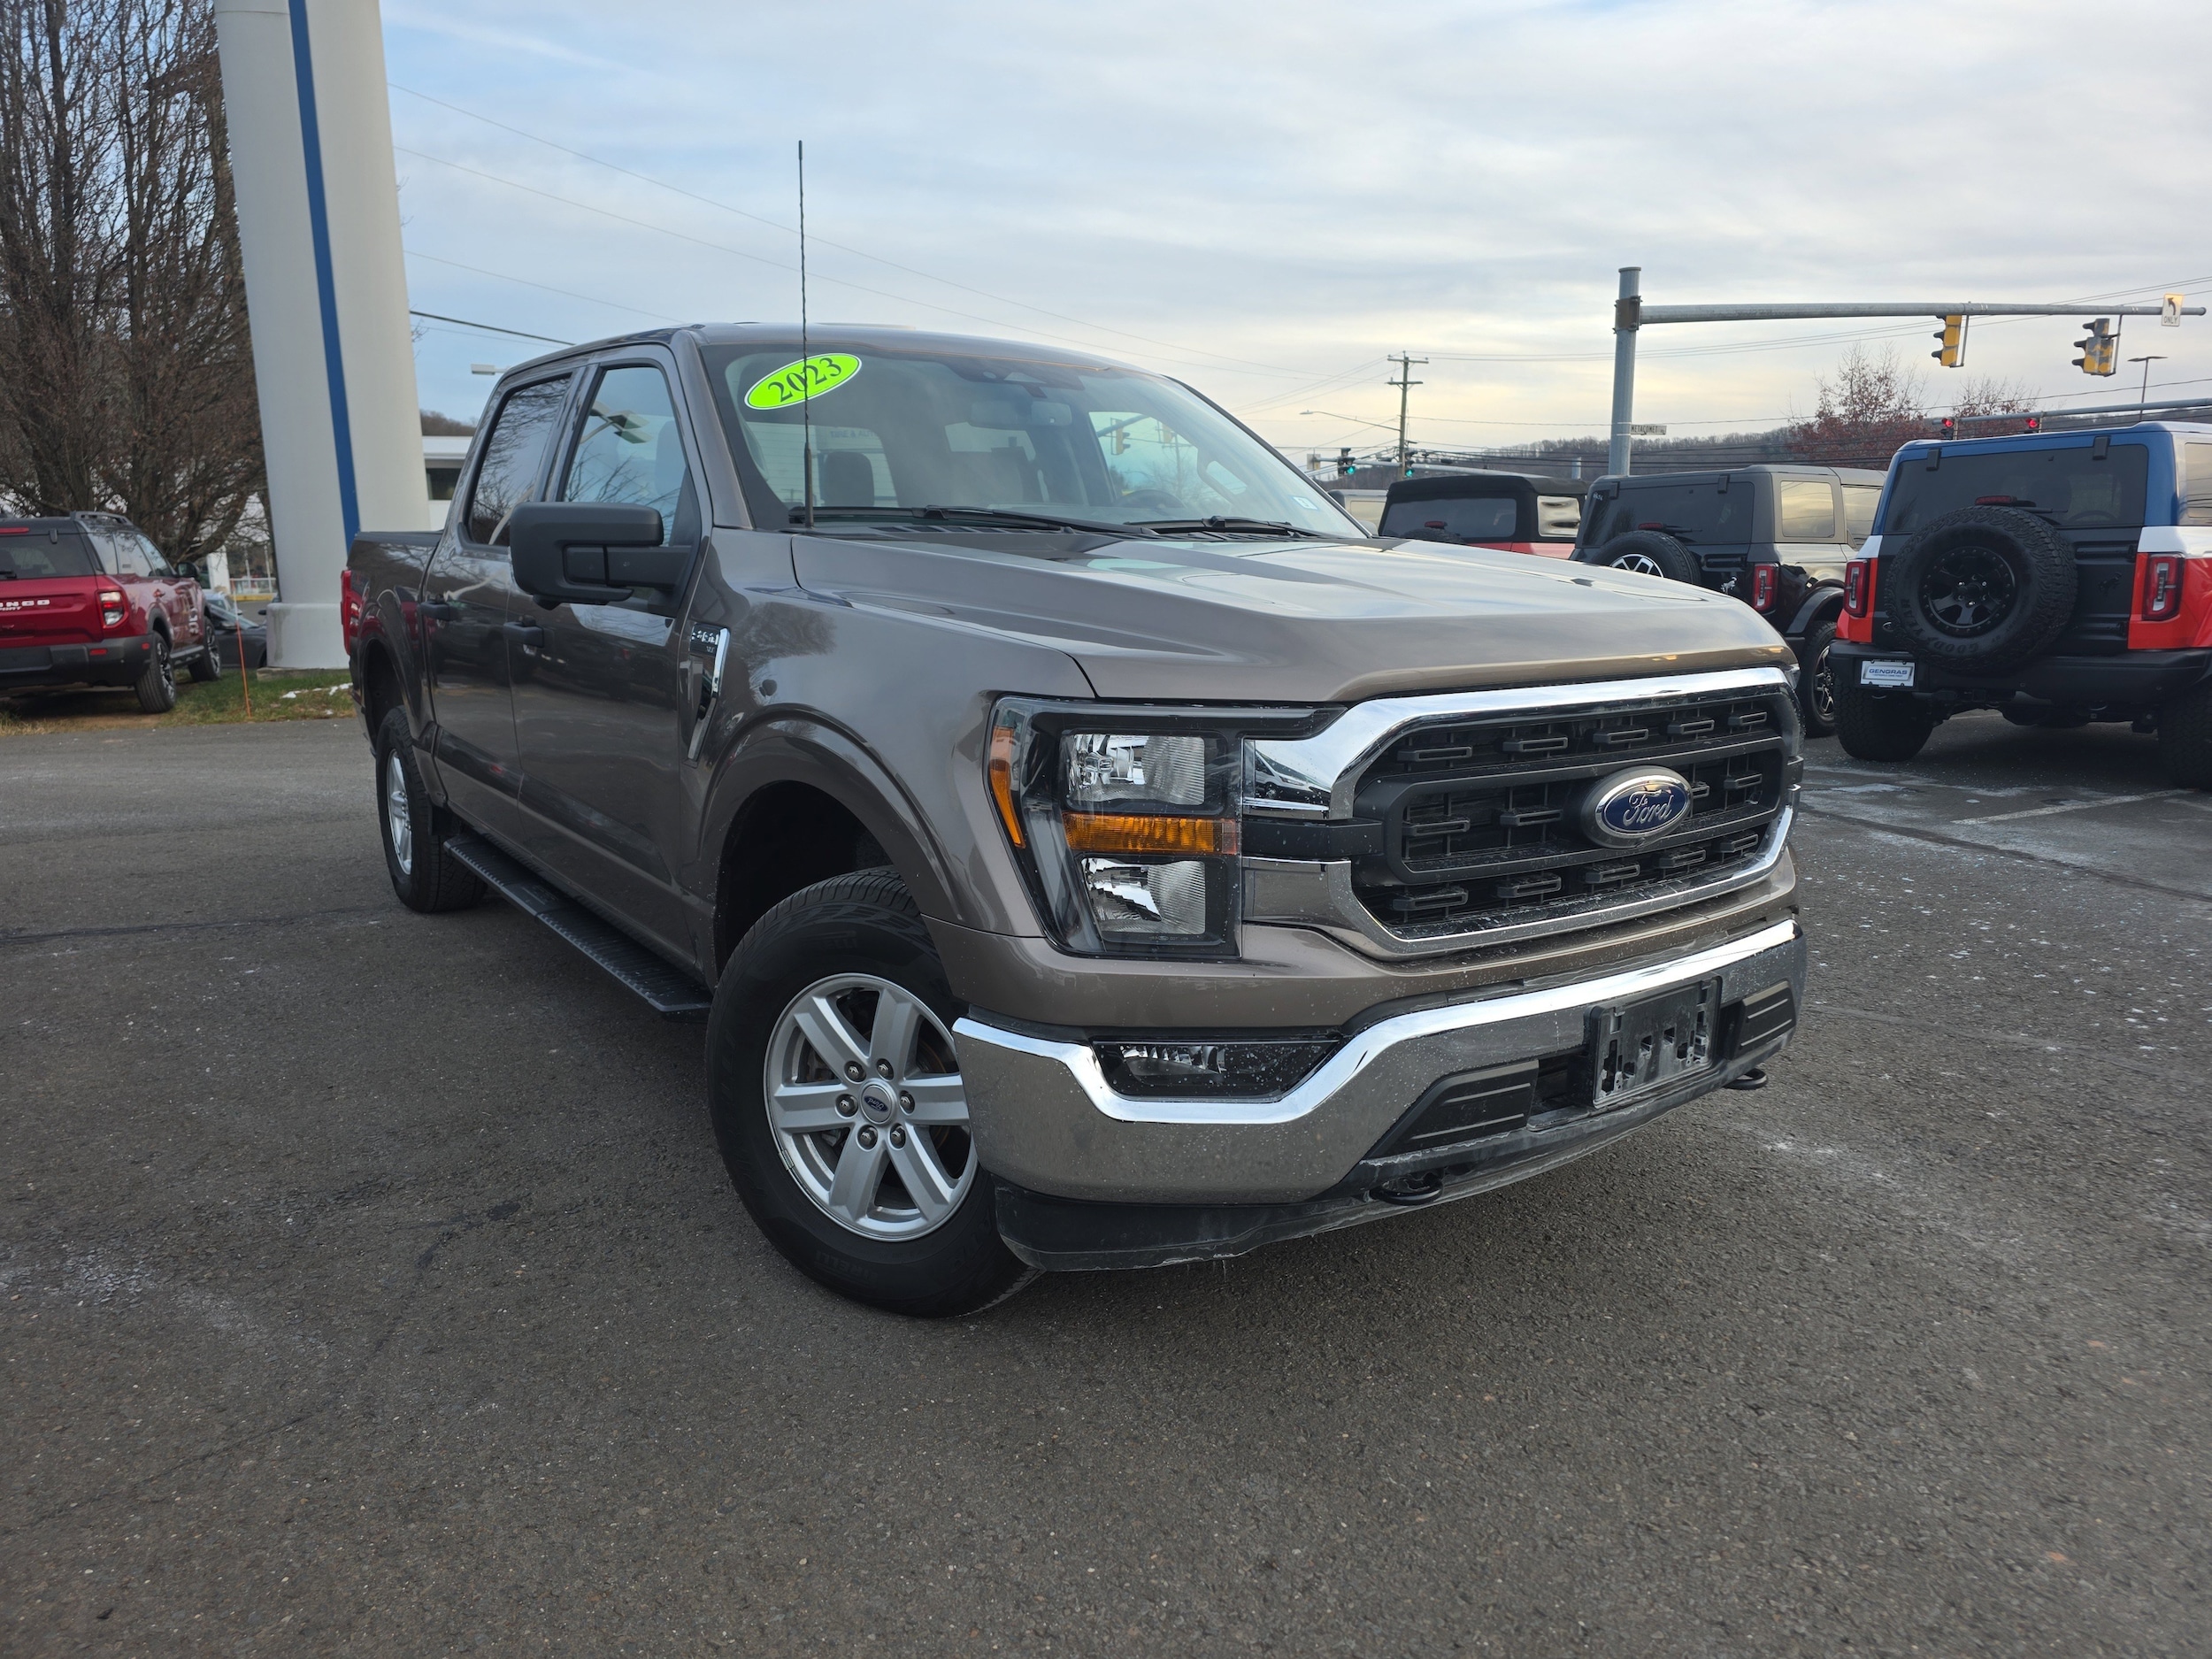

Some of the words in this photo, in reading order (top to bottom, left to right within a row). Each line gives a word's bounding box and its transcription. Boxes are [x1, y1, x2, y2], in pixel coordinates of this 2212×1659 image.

[768, 357, 841, 402] 2023
[1623, 789, 1674, 826] Ford
[867, 1097, 884, 1111] Ford
